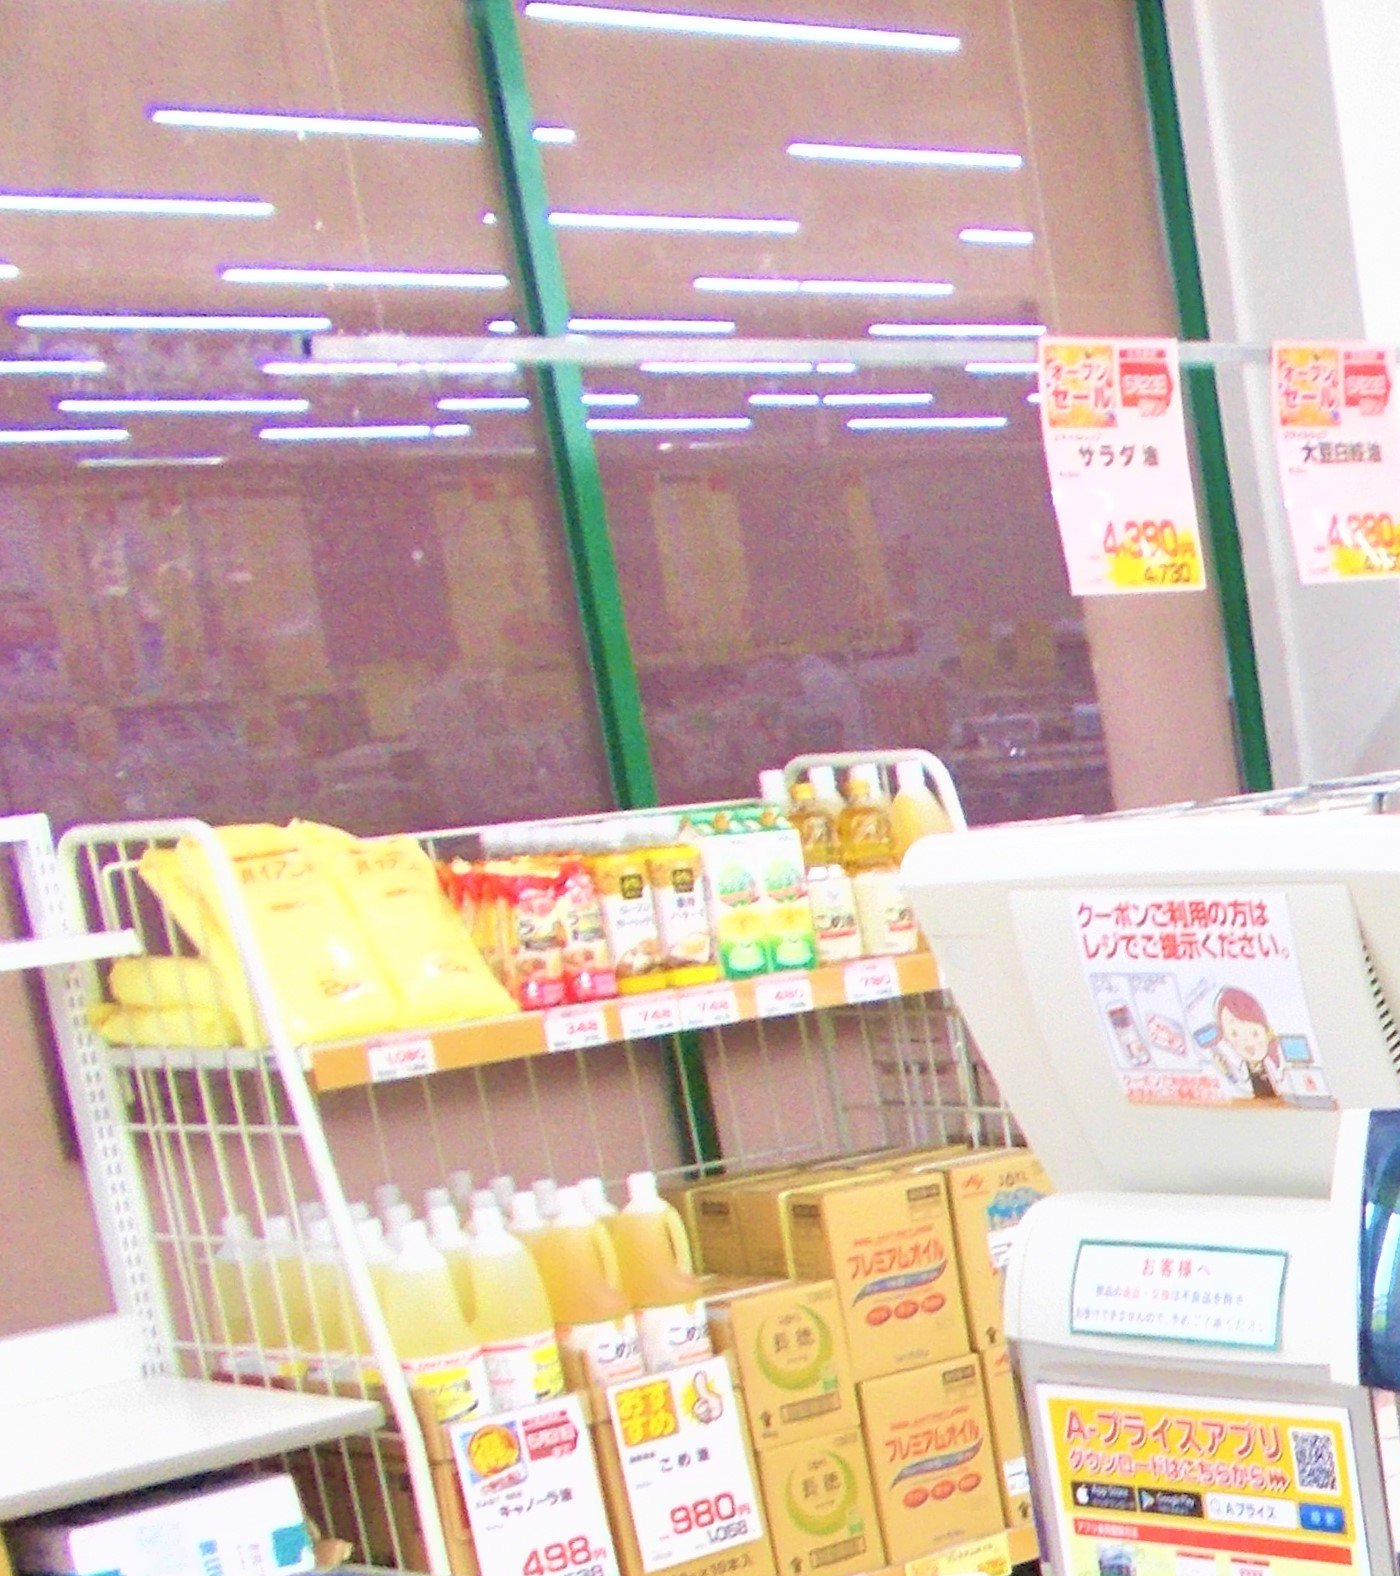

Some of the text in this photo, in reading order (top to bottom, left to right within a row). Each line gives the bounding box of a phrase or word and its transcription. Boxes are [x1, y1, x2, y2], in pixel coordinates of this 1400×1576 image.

[1079, 444, 1160, 467] サラダ油
[1077, 900, 1270, 929] クーポンご利用の方は
[1081, 933, 1291, 961] レジでご提示ください。
[848, 1238, 944, 1280] プレミアムオイル
[1142, 1257, 1211, 1278] お客様へ
[885, 1419, 981, 1461] プレミアムオイル
[1064, 1409, 1284, 1463] A-プライスアプリ
[669, 1491, 751, 1536] 980円
[1225, 1503, 1278, 1520] Aプライス
